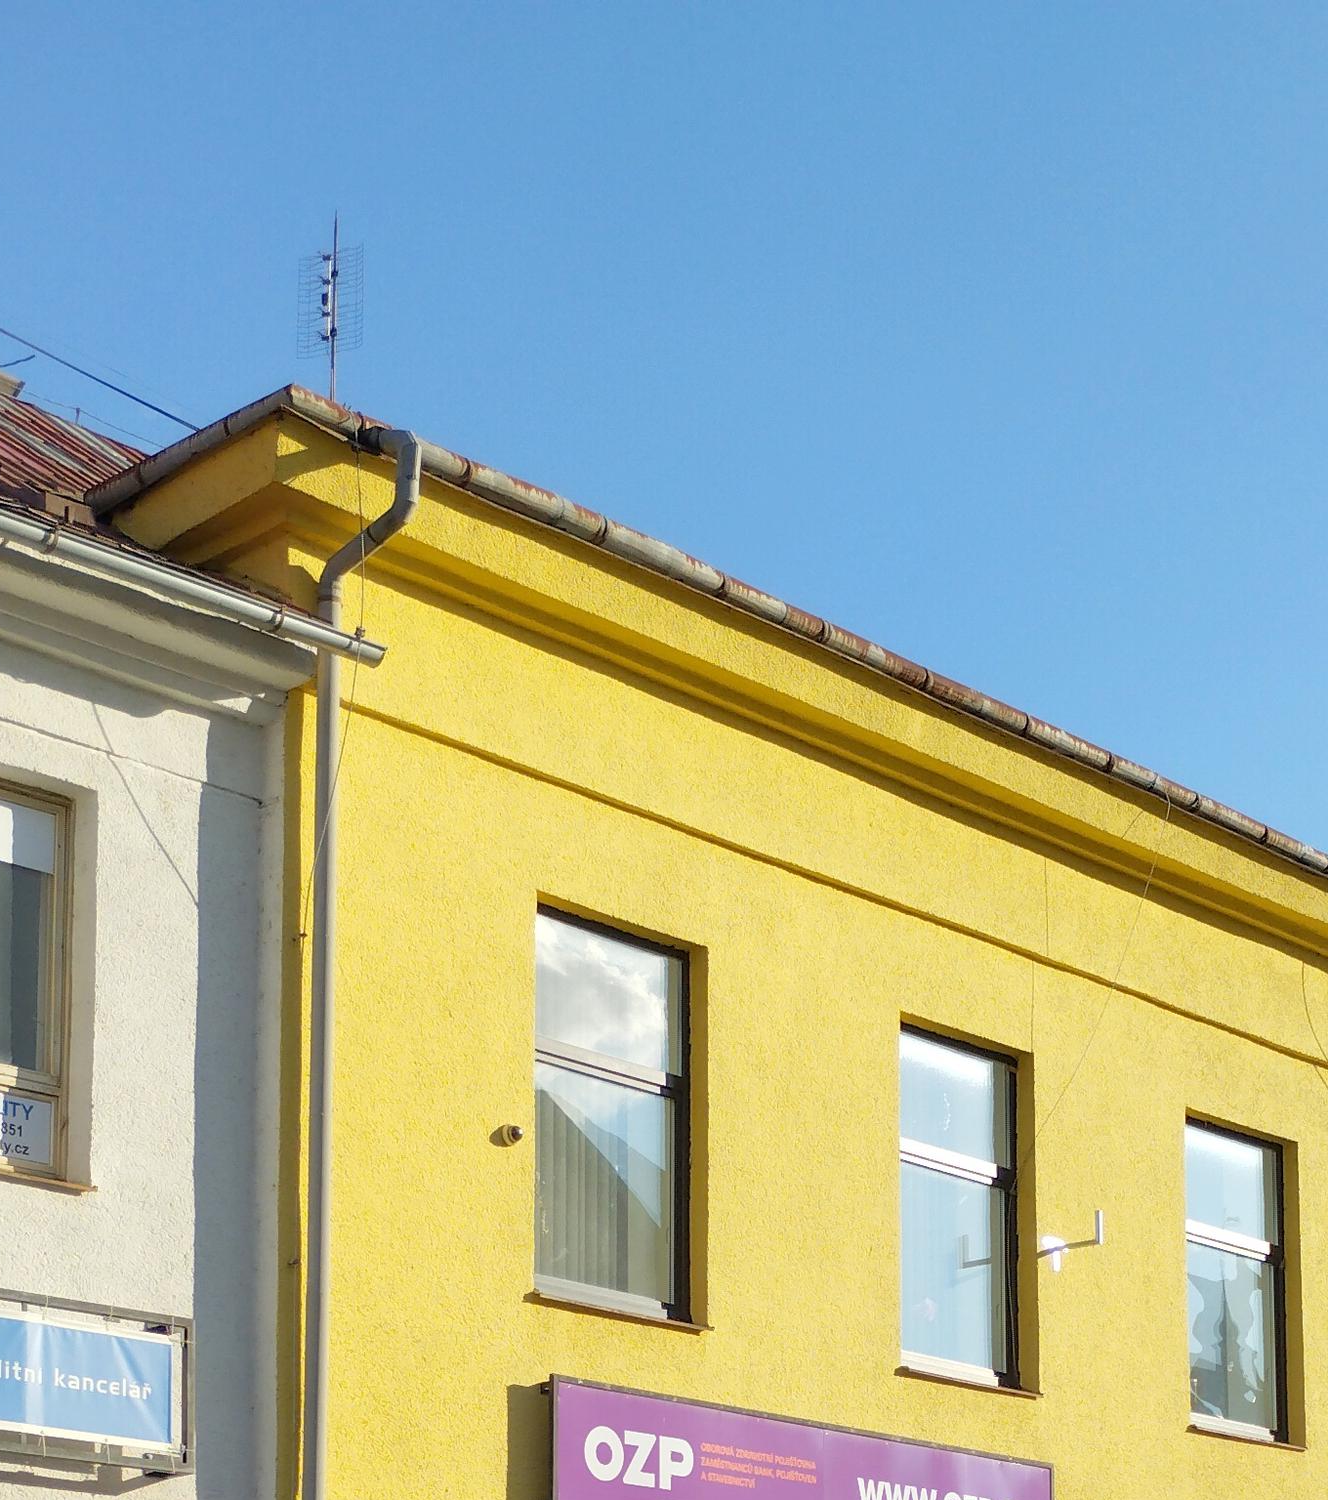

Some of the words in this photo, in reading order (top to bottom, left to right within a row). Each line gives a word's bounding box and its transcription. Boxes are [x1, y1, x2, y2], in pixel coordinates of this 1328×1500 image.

[1, 1121, 23, 1137] 851
[54, 1366, 153, 1401] kancelář
[583, 1425, 695, 1491] OZP
